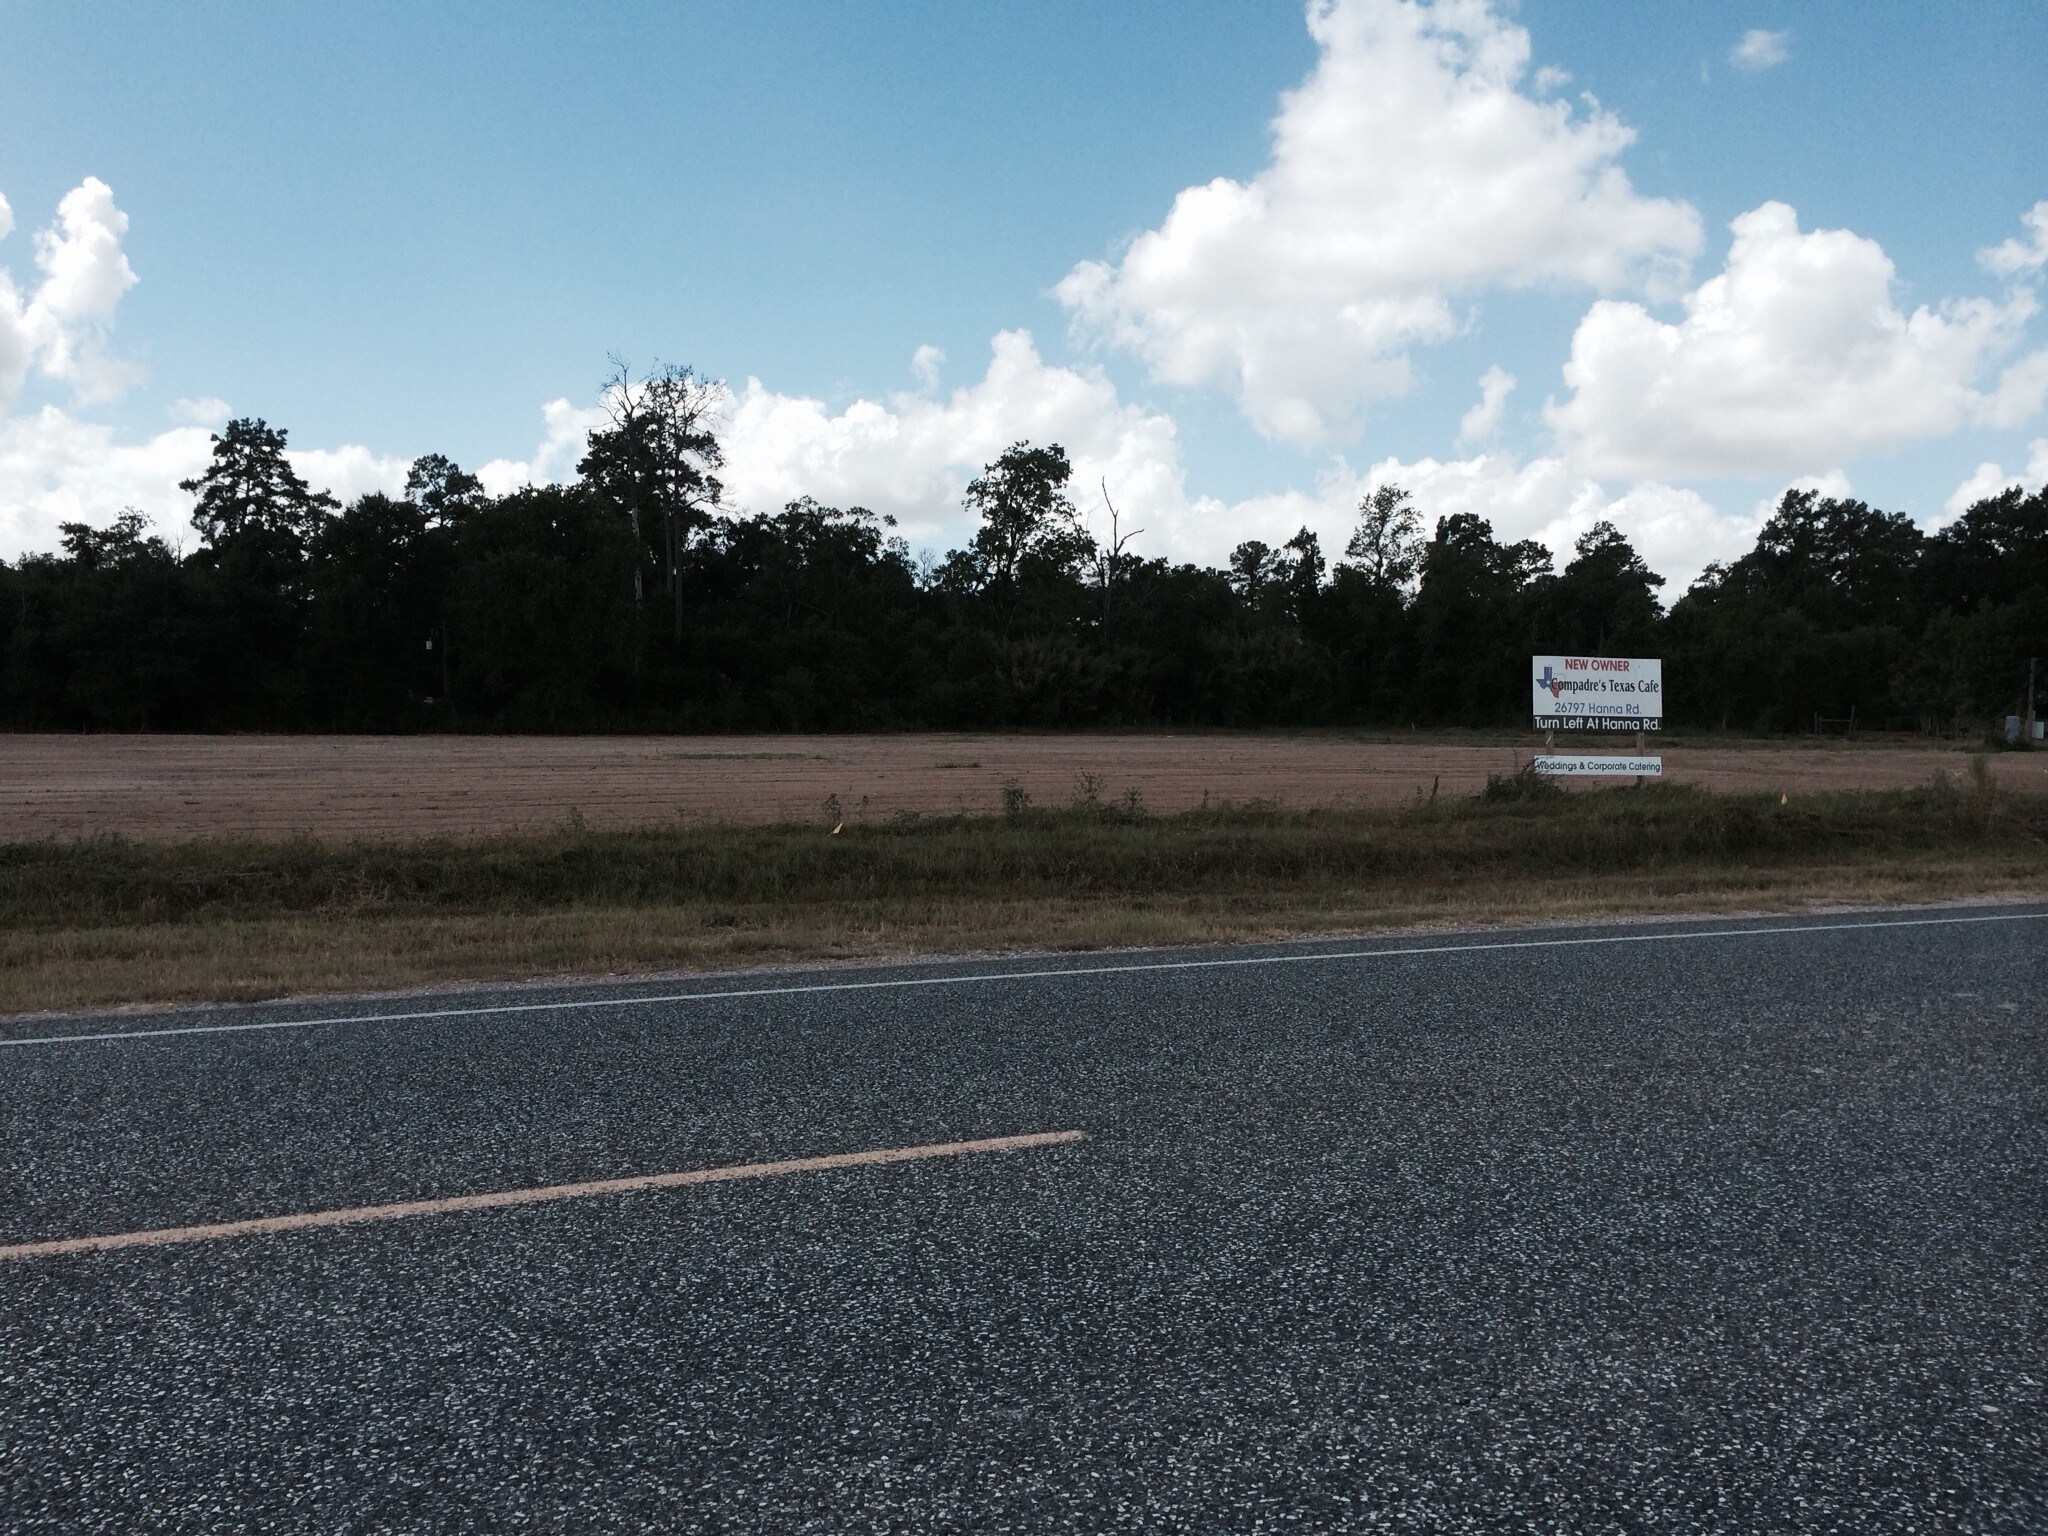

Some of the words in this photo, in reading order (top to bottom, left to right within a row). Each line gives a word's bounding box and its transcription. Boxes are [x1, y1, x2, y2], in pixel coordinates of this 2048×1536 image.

[1565, 659, 1588, 670] NEW
[1591, 660, 1630, 671] OWNER
[1551, 677, 1606, 694] Compadre's
[1609, 679, 1635, 692] Texas
[1638, 680, 1659, 692] Cafe
[1554, 702, 1585, 713] 26797
[1589, 703, 1623, 714] Hanna
[1626, 704, 1642, 715] Rd.
[1535, 717, 1560, 729] Turn
[1563, 717, 1583, 729] Left
[1586, 718, 1599, 729] At
[1602, 718, 1639, 730] Hanna
[1643, 719, 1661, 730] Rd.
[1579, 762, 1585, 770] &
[1587, 761, 1627, 771] Corporate
[1628, 762, 1660, 772] Catering
